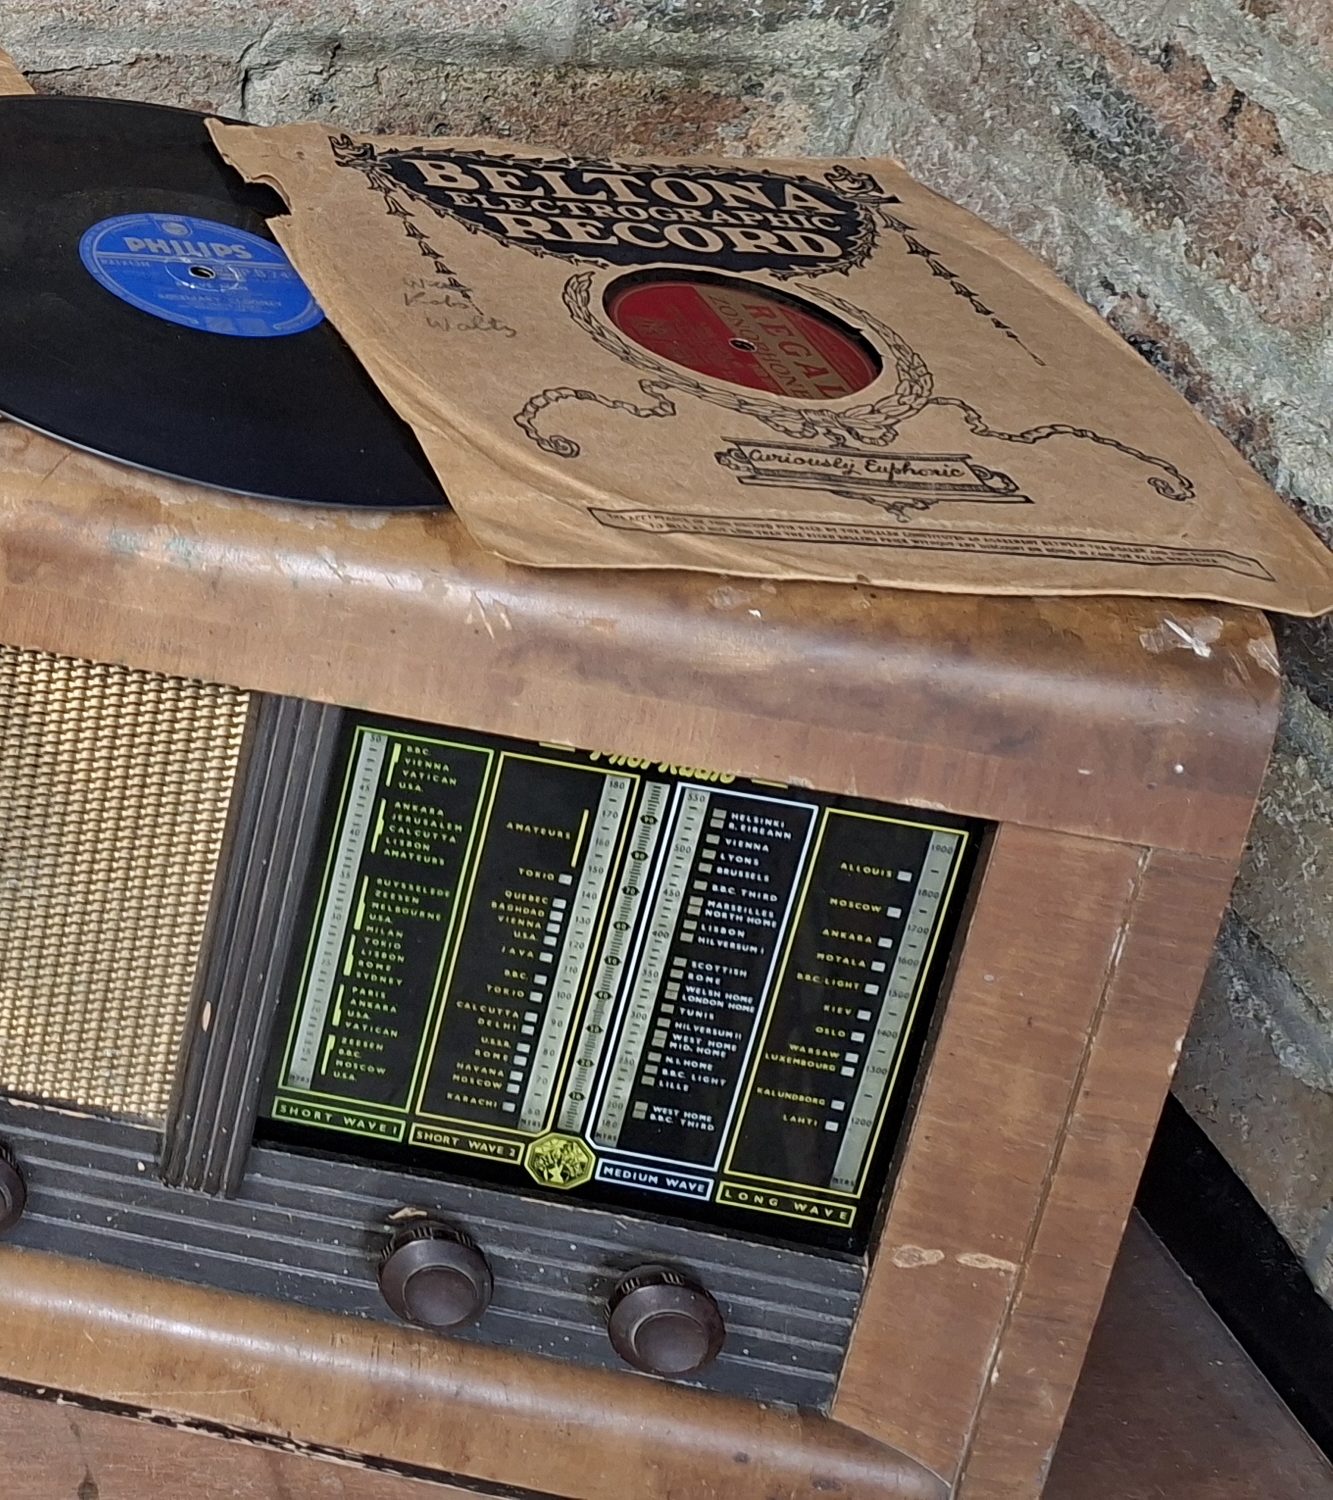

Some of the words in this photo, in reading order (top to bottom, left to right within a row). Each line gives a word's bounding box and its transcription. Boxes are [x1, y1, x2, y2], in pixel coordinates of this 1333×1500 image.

[407, 158, 848, 215] BELTONA
[444, 190, 841, 232] ELECTROGRAPHIC
[485, 211, 844, 258] RECORD
[123, 237, 253, 260] PHILIPS
[708, 295, 811, 398] ZONOPHONE
[741, 304, 850, 398] REGAL
[749, 450, 862, 475] Curiously
[864, 459, 967, 481] Euphonic
[404, 758, 450, 772] VIENNA
[402, 770, 458, 786] VATICAN
[609, 780, 625, 790] 180
[394, 802, 445, 817] ANKARA
[602, 810, 619, 819] 170
[391, 813, 463, 832] JERUSALEM
[731, 812, 785, 828] HELSINKI
[389, 824, 457, 844] CALCUTTA
[506, 822, 572, 840] AMATEURS
[385, 837, 431, 851] LISBON
[674, 845, 691, 853] 500
[725, 838, 769, 852] VIENNA
[383, 848, 445, 866] AMATEURS
[720, 853, 759, 866] LYONS
[716, 867, 769, 882] BRUSSELS
[840, 862, 892, 878] ALLOUIS
[375, 890, 420, 904] ZEESEN
[504, 890, 549, 905] QUEBEC
[741, 889, 778, 902] THIRD
[918, 889, 940, 900] 1800
[371, 902, 442, 921] MELBOURNE
[491, 901, 545, 917] BAGHDAD
[708, 900, 775, 919] MARSEILLES
[830, 898, 882, 913] MOSCOW
[497, 914, 542, 930] VIENNA
[705, 909, 743, 922] NORTH
[746, 916, 777, 928] HOME
[366, 925, 404, 939] MILAN
[652, 930, 669, 938] 400
[701, 924, 745, 938] LISBON
[822, 929, 872, 944] ANKARA
[501, 946, 534, 958] JAVA
[698, 937, 758, 953] HILVERSUM
[361, 949, 405, 963] LISBON
[817, 953, 866, 968] MOTALA
[358, 960, 392, 972] ROME
[691, 961, 748, 977] SCOTTISH
[356, 971, 403, 986] SYDNEY
[688, 972, 721, 985] ROME
[824, 978, 860, 990] LIGHT
[352, 986, 386, 999] PARIS
[685, 985, 721, 998] WELSH
[725, 991, 753, 1003] HOME
[350, 999, 397, 1013] ANKARA
[456, 1000, 520, 1018] CALCUTTA
[682, 994, 724, 1008] LONDON
[728, 1002, 755, 1013] HOME
[823, 1005, 852, 1015] KIEV
[680, 1007, 715, 1020] TUNIS
[345, 1021, 399, 1038] VATICAN
[478, 1017, 517, 1031] DELHI
[675, 1021, 735, 1038] HILVERSUM
[815, 1026, 846, 1038] OSLO
[341, 1037, 384, 1051] ZEESEN
[672, 1032, 703, 1045] WEST
[707, 1039, 737, 1052] HOME
[474, 1049, 509, 1063] ROME
[696, 1047, 726, 1059] HOME
[789, 1044, 840, 1059] WARSAW
[336, 1059, 386, 1075] MOSCOW
[456, 1062, 505, 1078] HAVANA
[681, 1058, 713, 1071] HOME
[765, 1053, 836, 1072] LUXEMBOURG
[867, 1066, 887, 1075] 1300
[452, 1074, 503, 1090] MOSCOW
[658, 1079, 689, 1092] LILLE
[691, 1074, 727, 1087] LIGHT
[447, 1092, 498, 1109] KARACHI
[757, 1087, 825, 1106] KALUNDBORG
[280, 1104, 334, 1122] SHORT
[343, 1115, 384, 1134] WAVE
[652, 1105, 680, 1117] WEST
[683, 1110, 712, 1123] HOME
[783, 1114, 818, 1127] LAHTI
[680, 1119, 715, 1132] THIRD
[851, 1117, 872, 1127] 1200
[416, 1131, 460, 1147] SHORT
[468, 1140, 505, 1156] WAVE
[603, 1166, 658, 1185] MEDIUM
[666, 1177, 705, 1193] WAVE
[724, 1189, 778, 1206] LONG
[793, 1202, 848, 1220] WAVE
